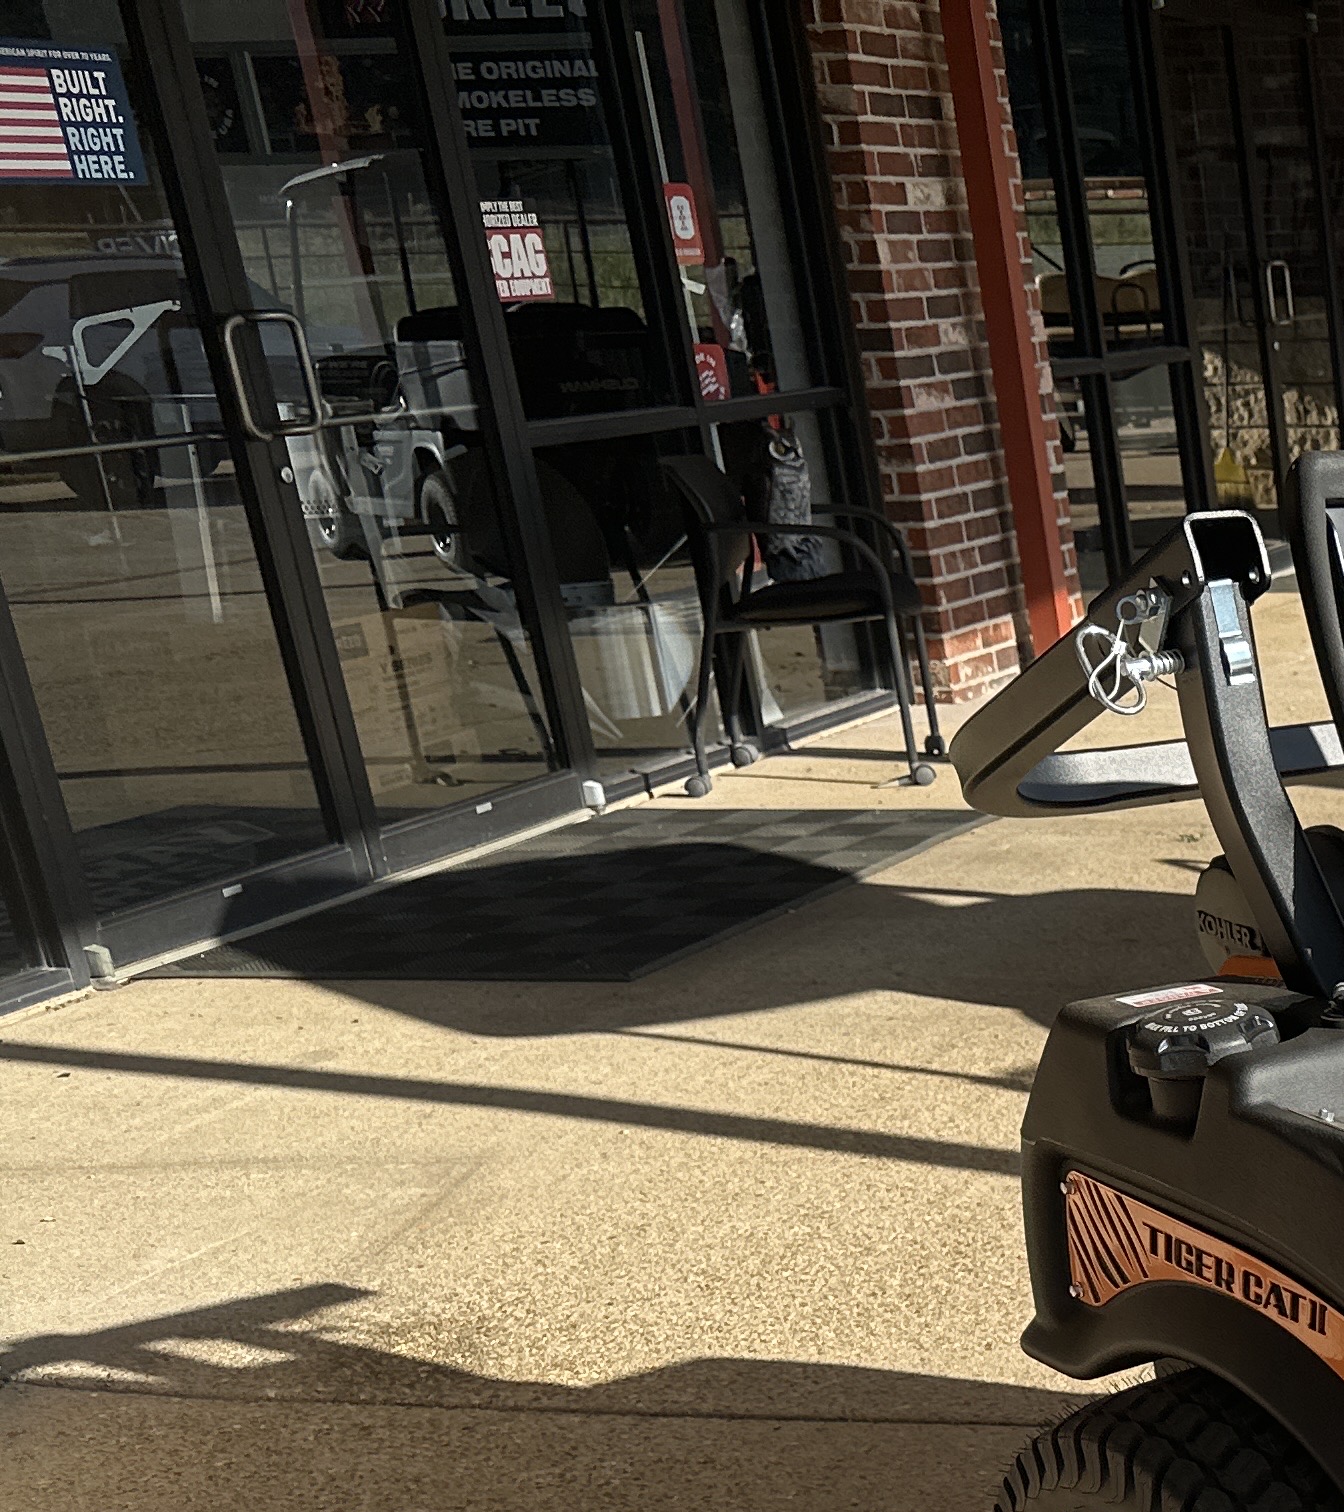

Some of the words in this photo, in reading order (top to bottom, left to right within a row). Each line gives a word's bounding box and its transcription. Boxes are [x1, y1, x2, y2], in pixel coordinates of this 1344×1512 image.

[480, 59, 598, 80] ORIGINAL
[50, 69, 106, 95] BUILT
[58, 97, 124, 123] RIGHT.
[458, 88, 597, 109] MOKELESS
[500, 118, 540, 136] PIT
[66, 127, 125, 152] RIGHT
[73, 155, 134, 178] HERE.
[512, 214, 538, 226] DEALER
[487, 233, 548, 278] CAG
[509, 278, 552, 296] EQUIPMENT
[1197, 910, 1250, 949] KOHLER
[1182, 1024, 1198, 1032] TO
[1200, 1014, 1240, 1030] BOTTOM
[1142, 1221, 1235, 1293] TIGER
